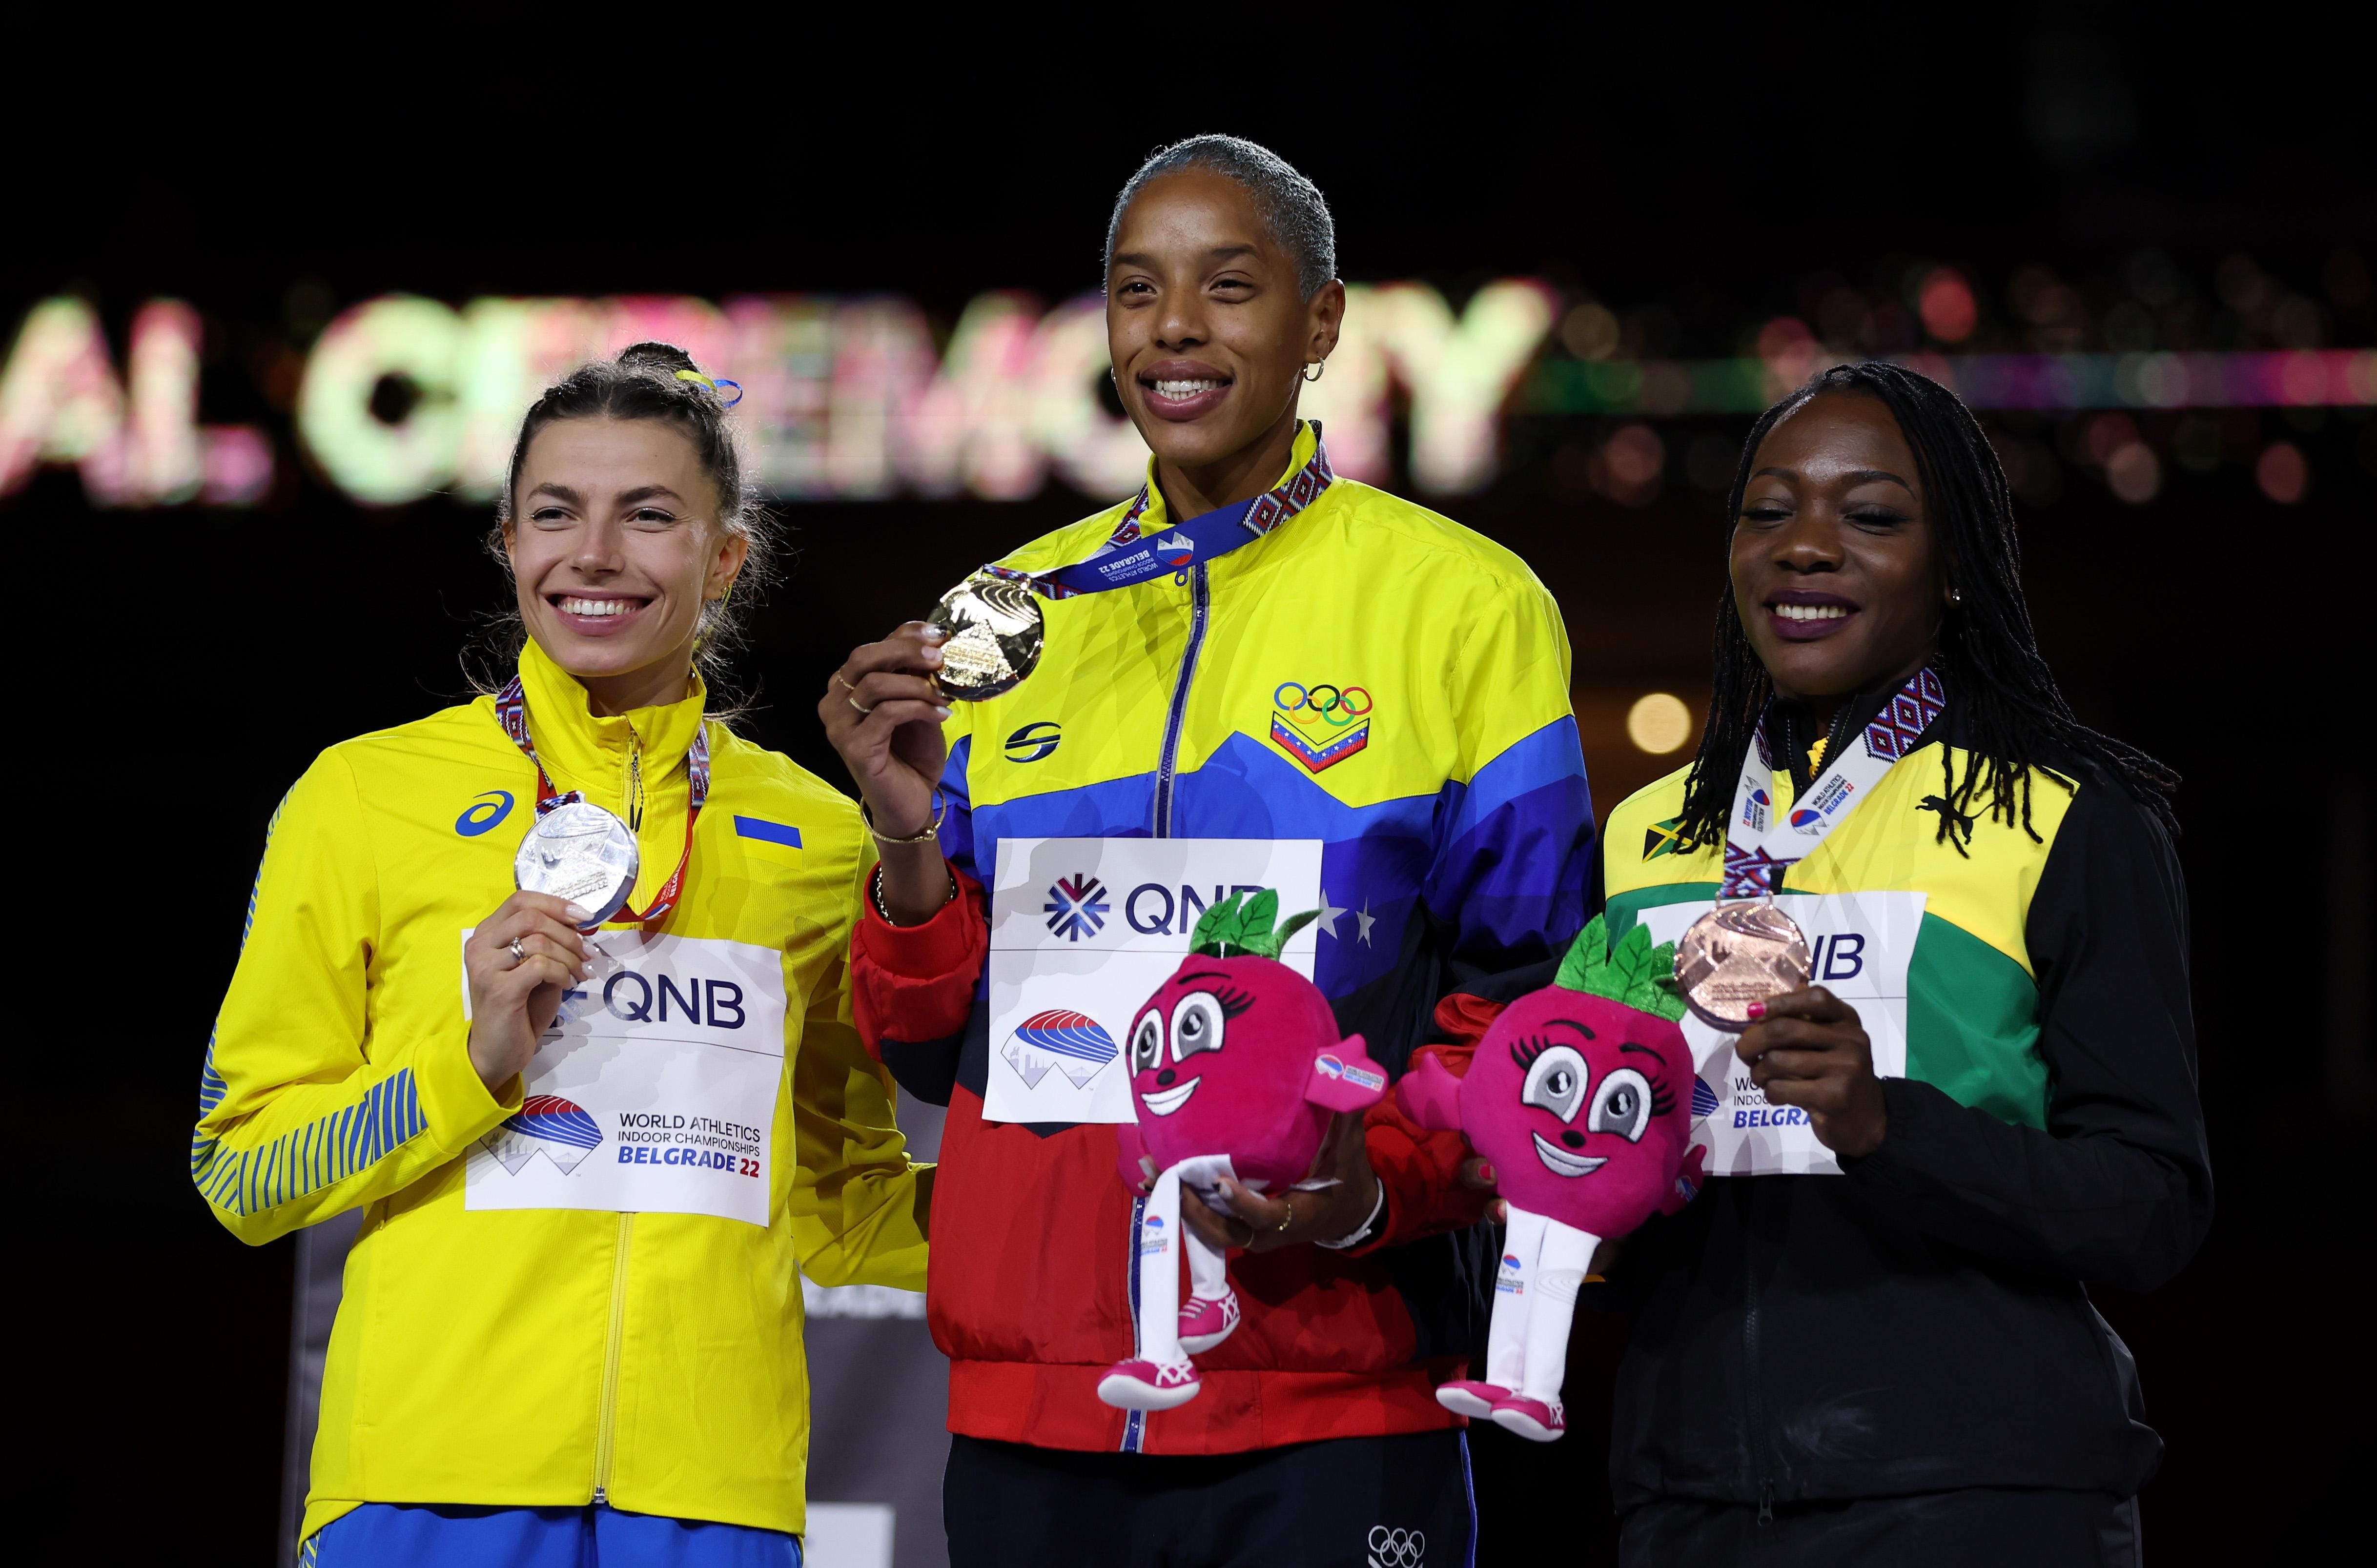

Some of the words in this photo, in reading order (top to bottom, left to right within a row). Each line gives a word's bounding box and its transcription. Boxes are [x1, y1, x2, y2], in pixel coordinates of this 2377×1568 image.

[1109, 550, 1150, 570] BELGRADE
[1137, 557, 1154, 567] INDOOR
[1137, 563, 1158, 573] WORLD
[1108, 570, 1137, 582] ATHLETICS
[1811, 792, 1826, 806] WORLD
[1823, 774, 1842, 794] ATHLETICS
[1824, 789, 1848, 815] BELGRADE
[1845, 783, 1854, 792] 22
[603, 971, 745, 1030] QNB
[620, 1113, 685, 1128] WORLD
[690, 1117, 760, 1142] ATHLETICS
[618, 1131, 671, 1142] INDOOR
[675, 1133, 759, 1157] CHAMPIONSHIPS
[618, 1146, 736, 1172] BELGRADE
[740, 1158, 759, 1178] 22
